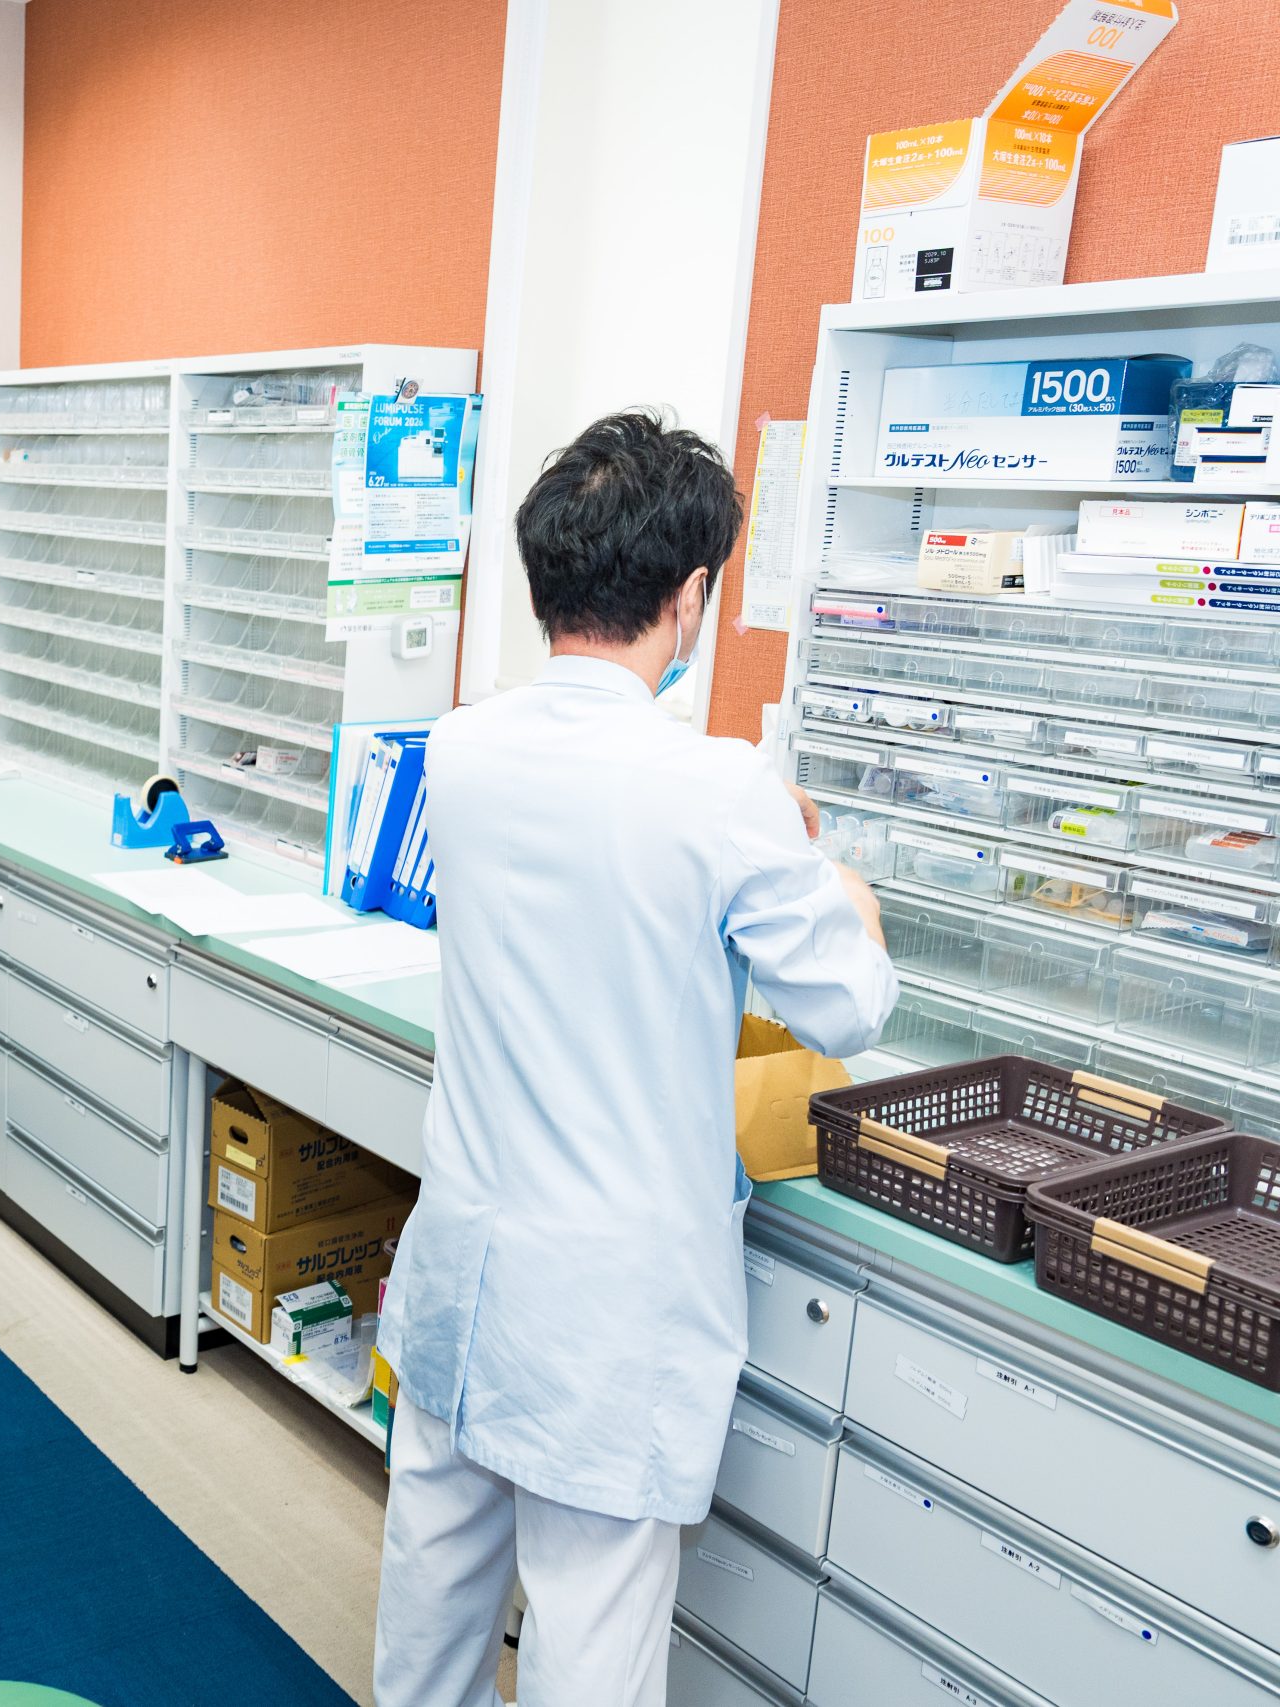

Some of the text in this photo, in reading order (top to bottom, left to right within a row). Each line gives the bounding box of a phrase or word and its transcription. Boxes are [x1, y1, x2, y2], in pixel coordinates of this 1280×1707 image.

[1087, 26, 1125, 49] 100
[863, 226, 896, 245] 100
[1032, 367, 1110, 405] 1500
[375, 403, 425, 414] LUMIPULSE
[374, 416, 402, 427] FORUM
[1115, 459, 1136, 474] 1500
[368, 475, 385, 487] 6.27
[296, 1236, 383, 1276] サルプレップ
[1023, 1384, 1036, 1394] A-1
[1028, 1561, 1040, 1573] A-2
